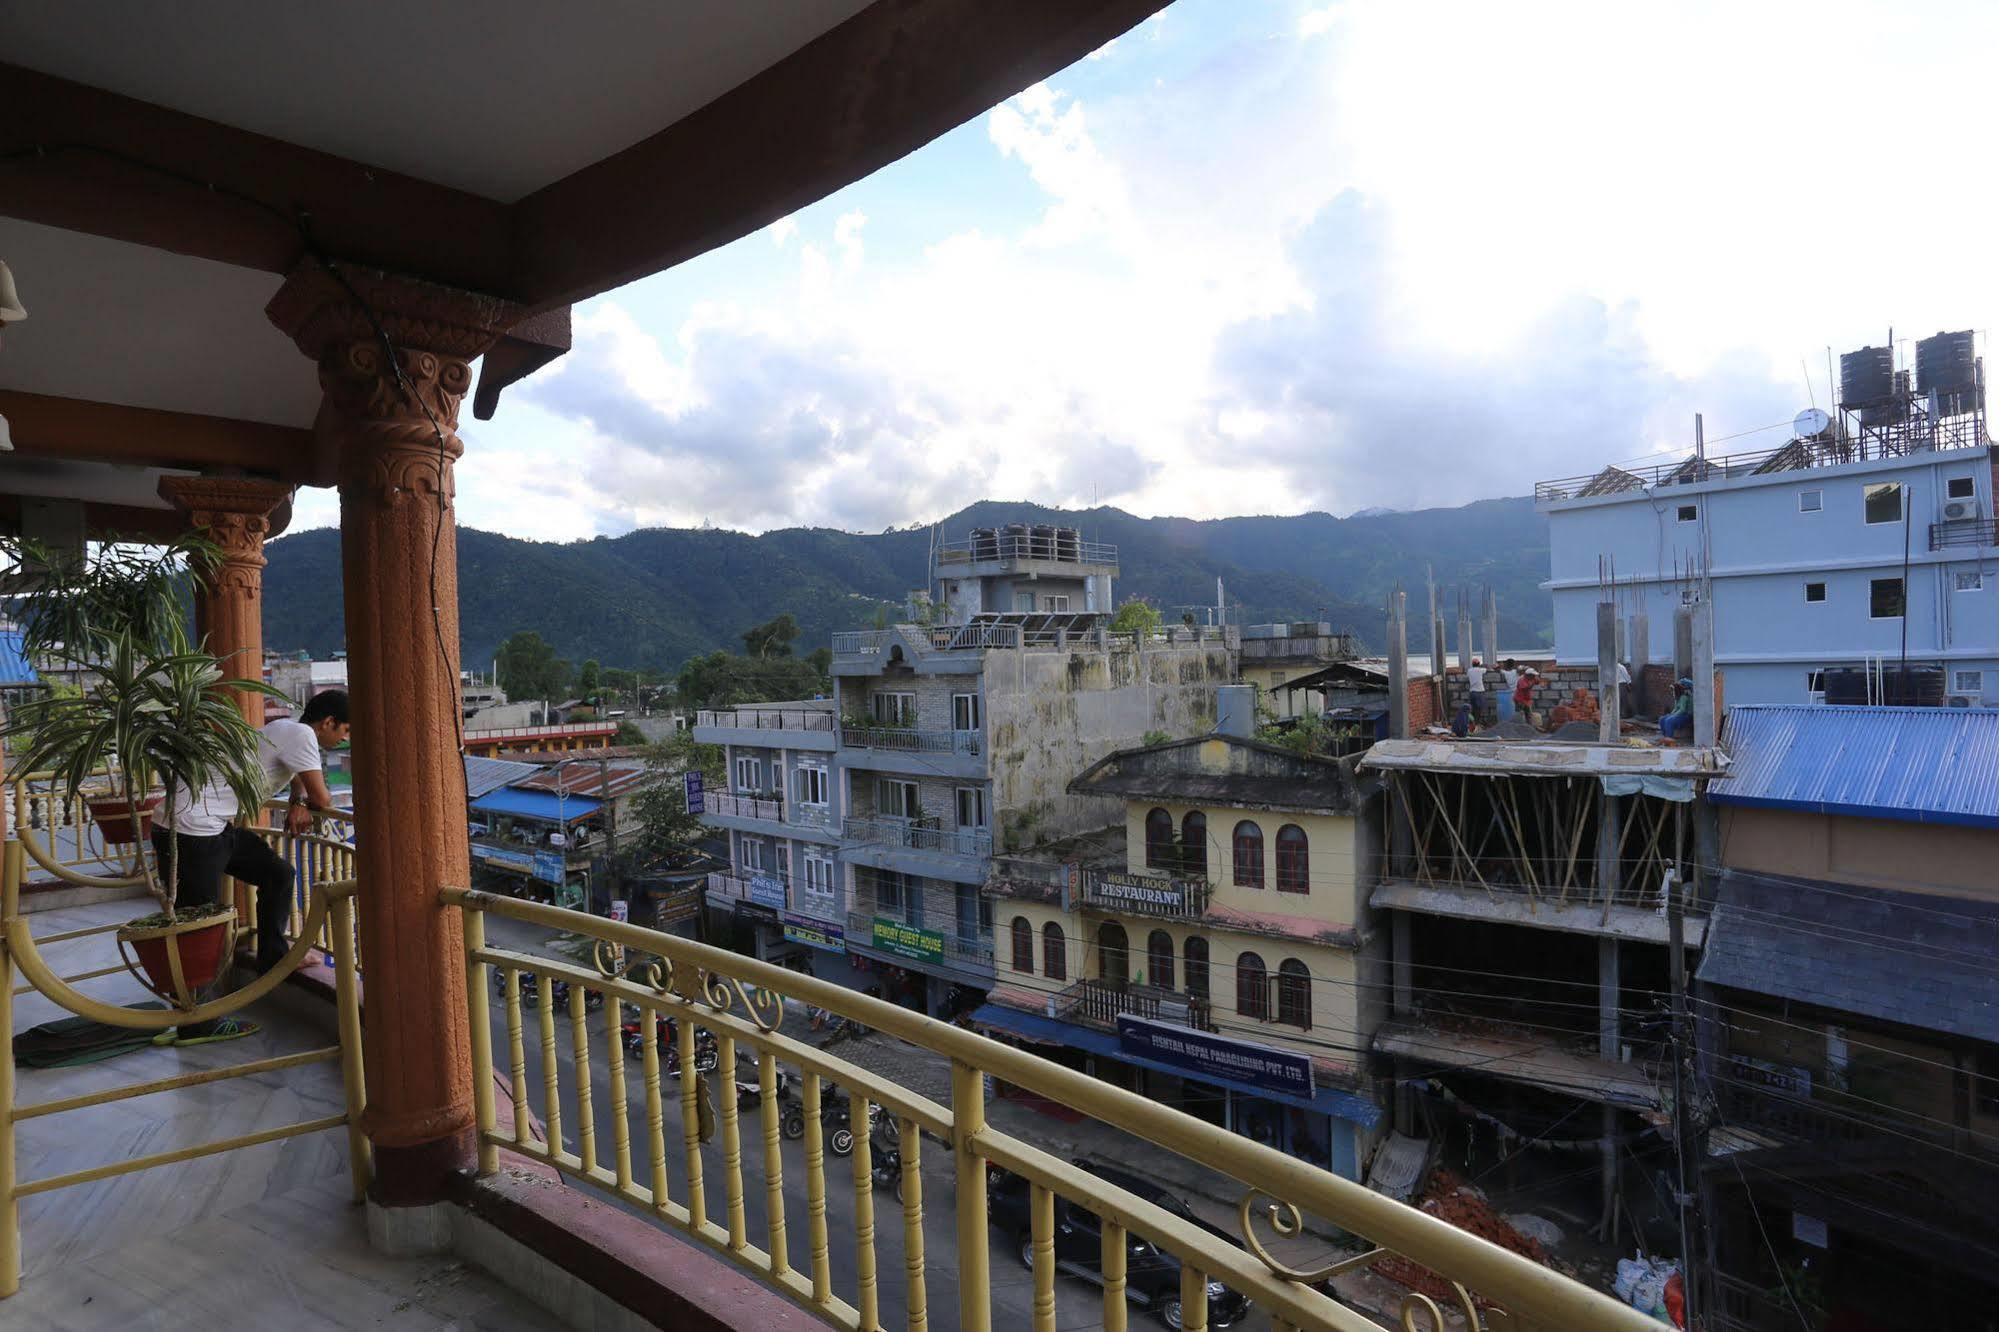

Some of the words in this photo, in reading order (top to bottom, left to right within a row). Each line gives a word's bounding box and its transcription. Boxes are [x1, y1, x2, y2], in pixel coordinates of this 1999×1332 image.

[690, 803, 704, 813] HOUSE
[1100, 882, 1181, 905] RESTAURANT
[1107, 873, 1138, 887] HOLLY
[1142, 878, 1173, 891] HOCK
[873, 923, 898, 941] MEMORY
[899, 930, 919, 946] GUEST
[920, 935, 942, 952] HOUSE
[1151, 1034, 1185, 1053] FISHTAIL
[1186, 1042, 1210, 1060] NEPAL
[1210, 1049, 1265, 1071] PARAGLIDING
[1265, 1061, 1285, 1078] PVT.
[1285, 1065, 1305, 1081] LTD.
